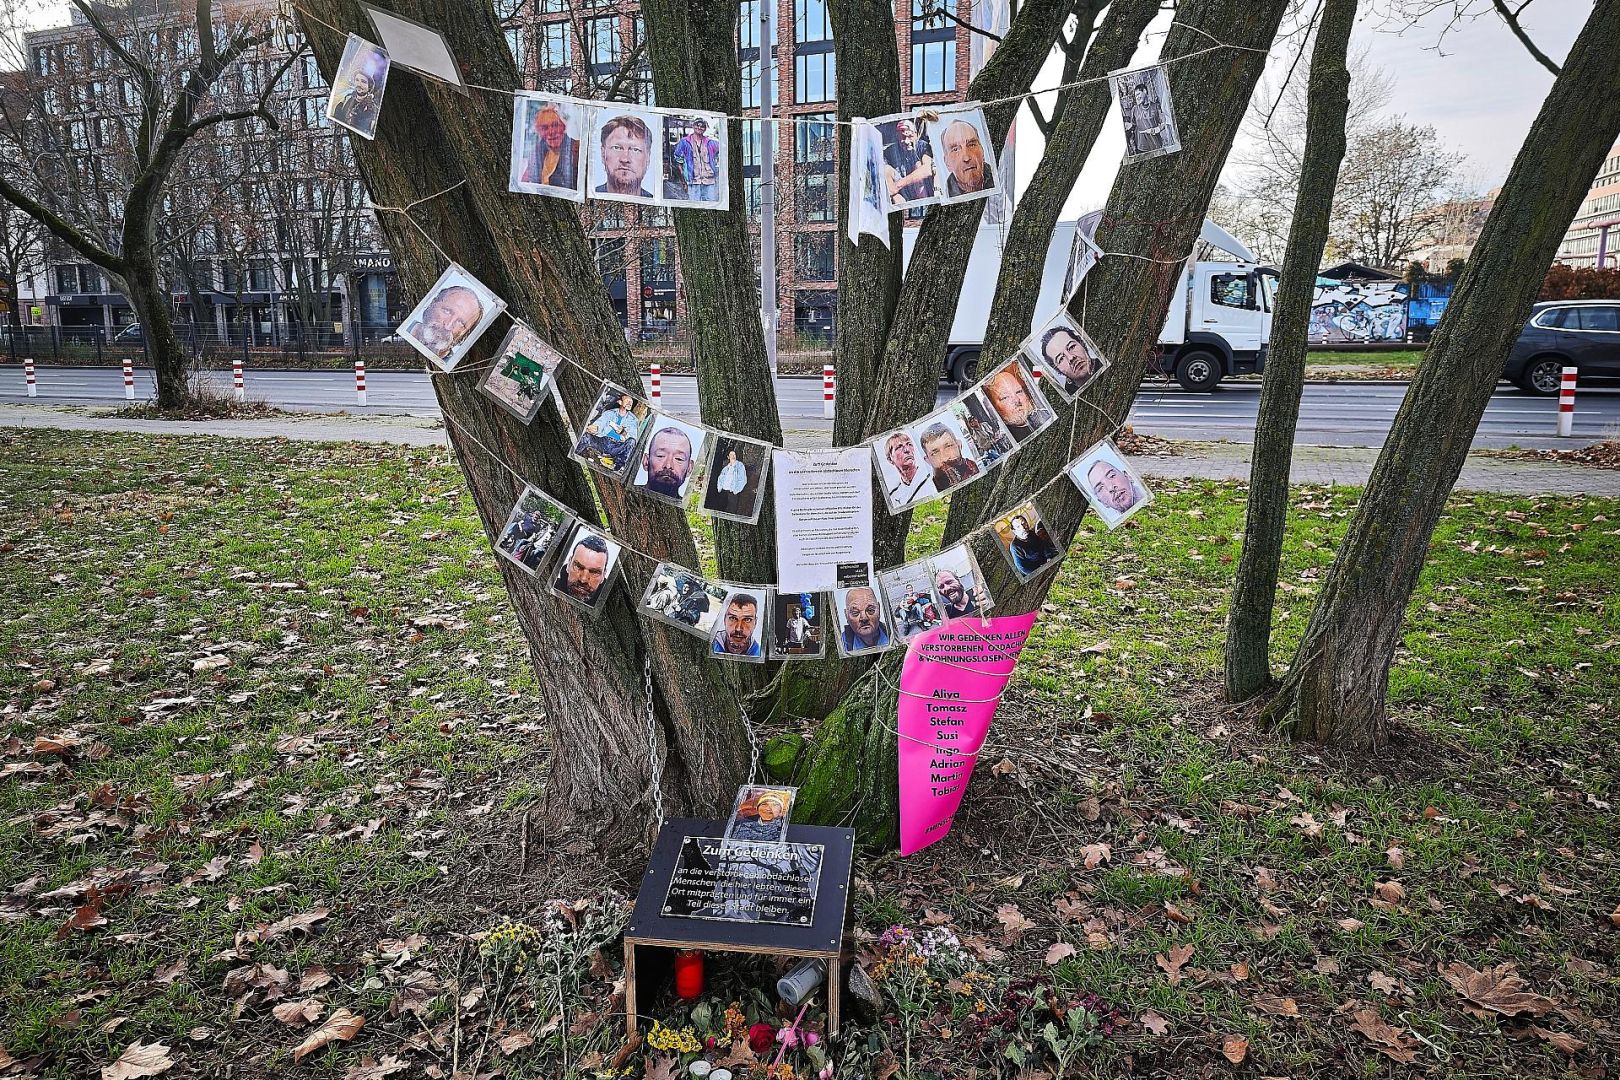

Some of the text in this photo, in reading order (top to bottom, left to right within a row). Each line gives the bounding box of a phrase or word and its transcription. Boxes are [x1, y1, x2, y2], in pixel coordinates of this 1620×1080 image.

[957, 633, 1002, 642] GEDENKEN
[1004, 629, 1026, 641] ALLEN
[921, 643, 984, 652] VERSTORBENEN
[926, 703, 967, 713] Tomasz
[930, 716, 964, 726] Stefan
[937, 730, 958, 740] Susi
[930, 759, 965, 769] Adrian
[703, 845, 799, 861] Zum Gedenken
[690, 867, 703, 875] die
[762, 872, 815, 883] obdachlosen
[672, 877, 812, 893] Menschen, die hier lebten, diesen
[671, 887, 812, 905] Ort mitprägten und für immer ein
[687, 899, 701, 908] Teil
[731, 902, 755, 911] Stadt
[756, 903, 790, 914] bleiben.
